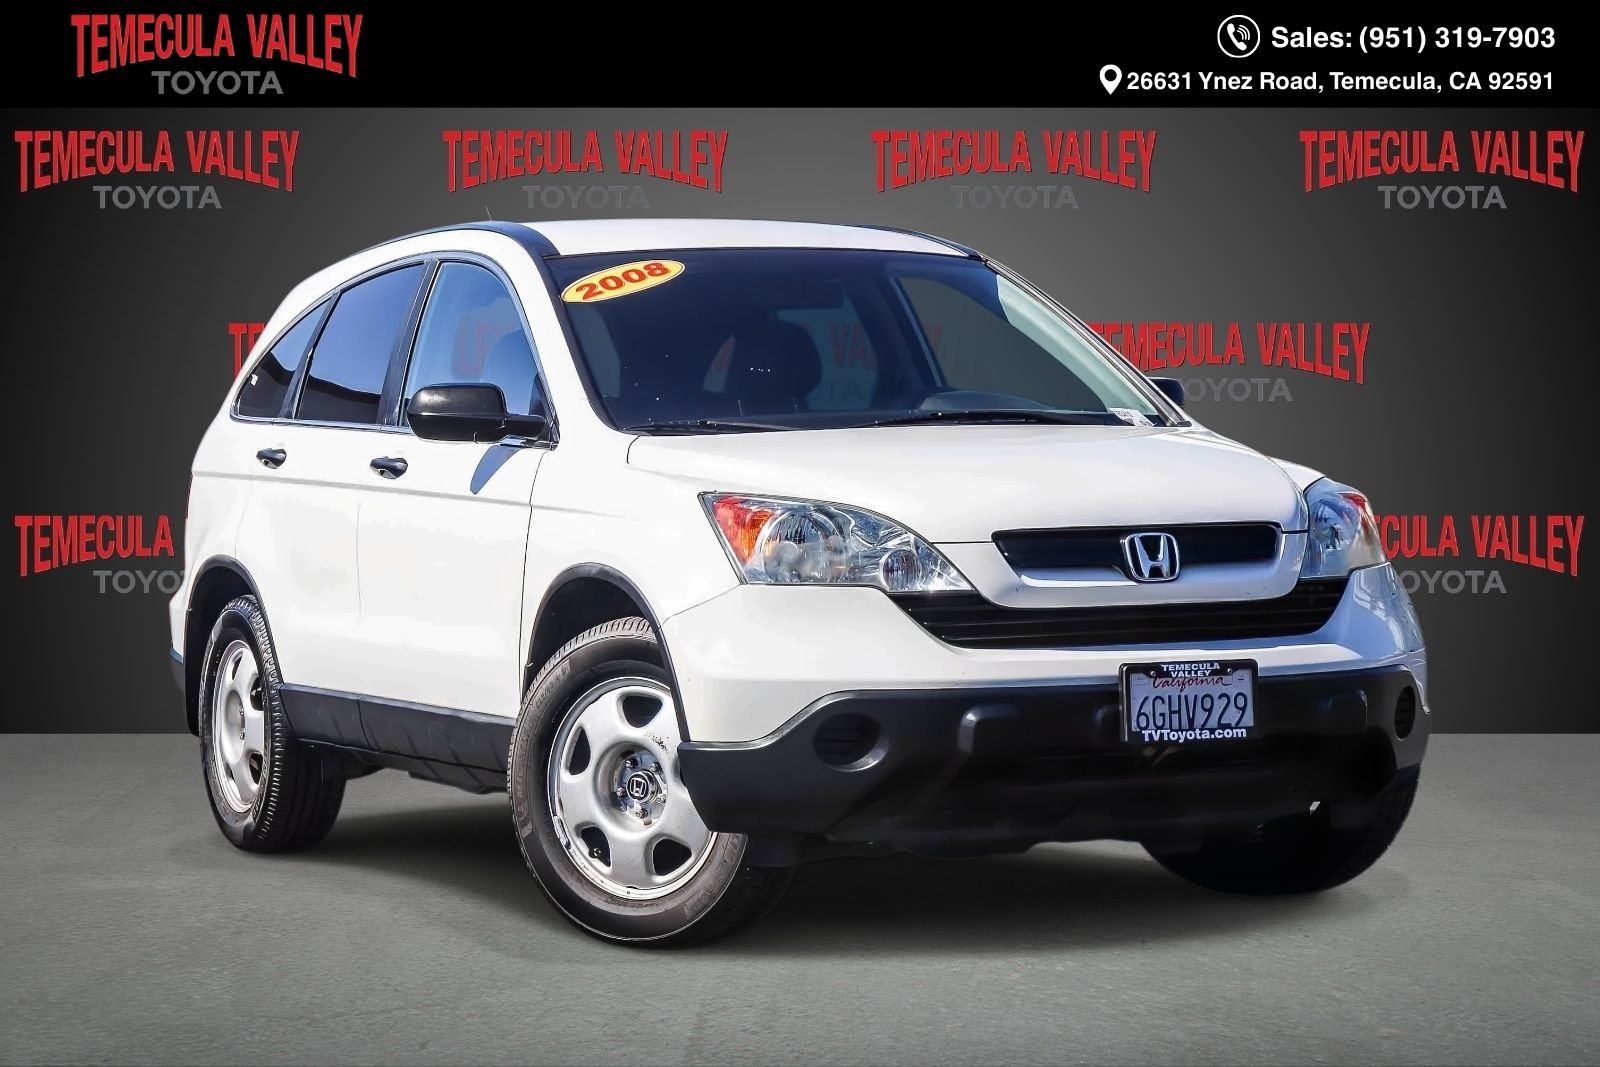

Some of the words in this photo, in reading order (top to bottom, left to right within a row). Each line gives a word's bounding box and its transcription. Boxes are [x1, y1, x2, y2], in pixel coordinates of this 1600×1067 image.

[14, 130, 174, 192] TEMECULA
[186, 130, 299, 192] VALLEY
[442, 130, 602, 192] TEMECULA
[614, 130, 727, 192] VALLEY
[871, 130, 1031, 192] TEMECULA
[1043, 130, 1156, 192] VALLEY
[1299, 130, 1459, 192] TEMECULA
[1471, 130, 1584, 192] VALLEY
[93, 185, 222, 209] TOYOTA
[521, 185, 650, 209] TOYOTA
[949, 185, 1078, 209] TOYOTA
[1377, 185, 1506, 209] TOYOTA
[575, 262, 672, 301] 2008
[1087, 322, 1245, 371] MECULA
[1257, 322, 1370, 384] VALLEY
[1183, 377, 1293, 401] OYOTA
[14, 514, 174, 577] TEMECULA
[1377, 514, 1460, 560] CULA
[1471, 514, 1584, 577] VALLEY
[93, 570, 184, 594] TOYO
[1400, 570, 1507, 594] OYOTA
[1161, 662, 1220, 672] TEMECULA
[1170, 669, 1212, 678] VALLEY
[1152, 676, 1232, 693] California
[1136, 691, 1248, 731] 6GHV929
[1142, 727, 1247, 743] TVToyota.com
